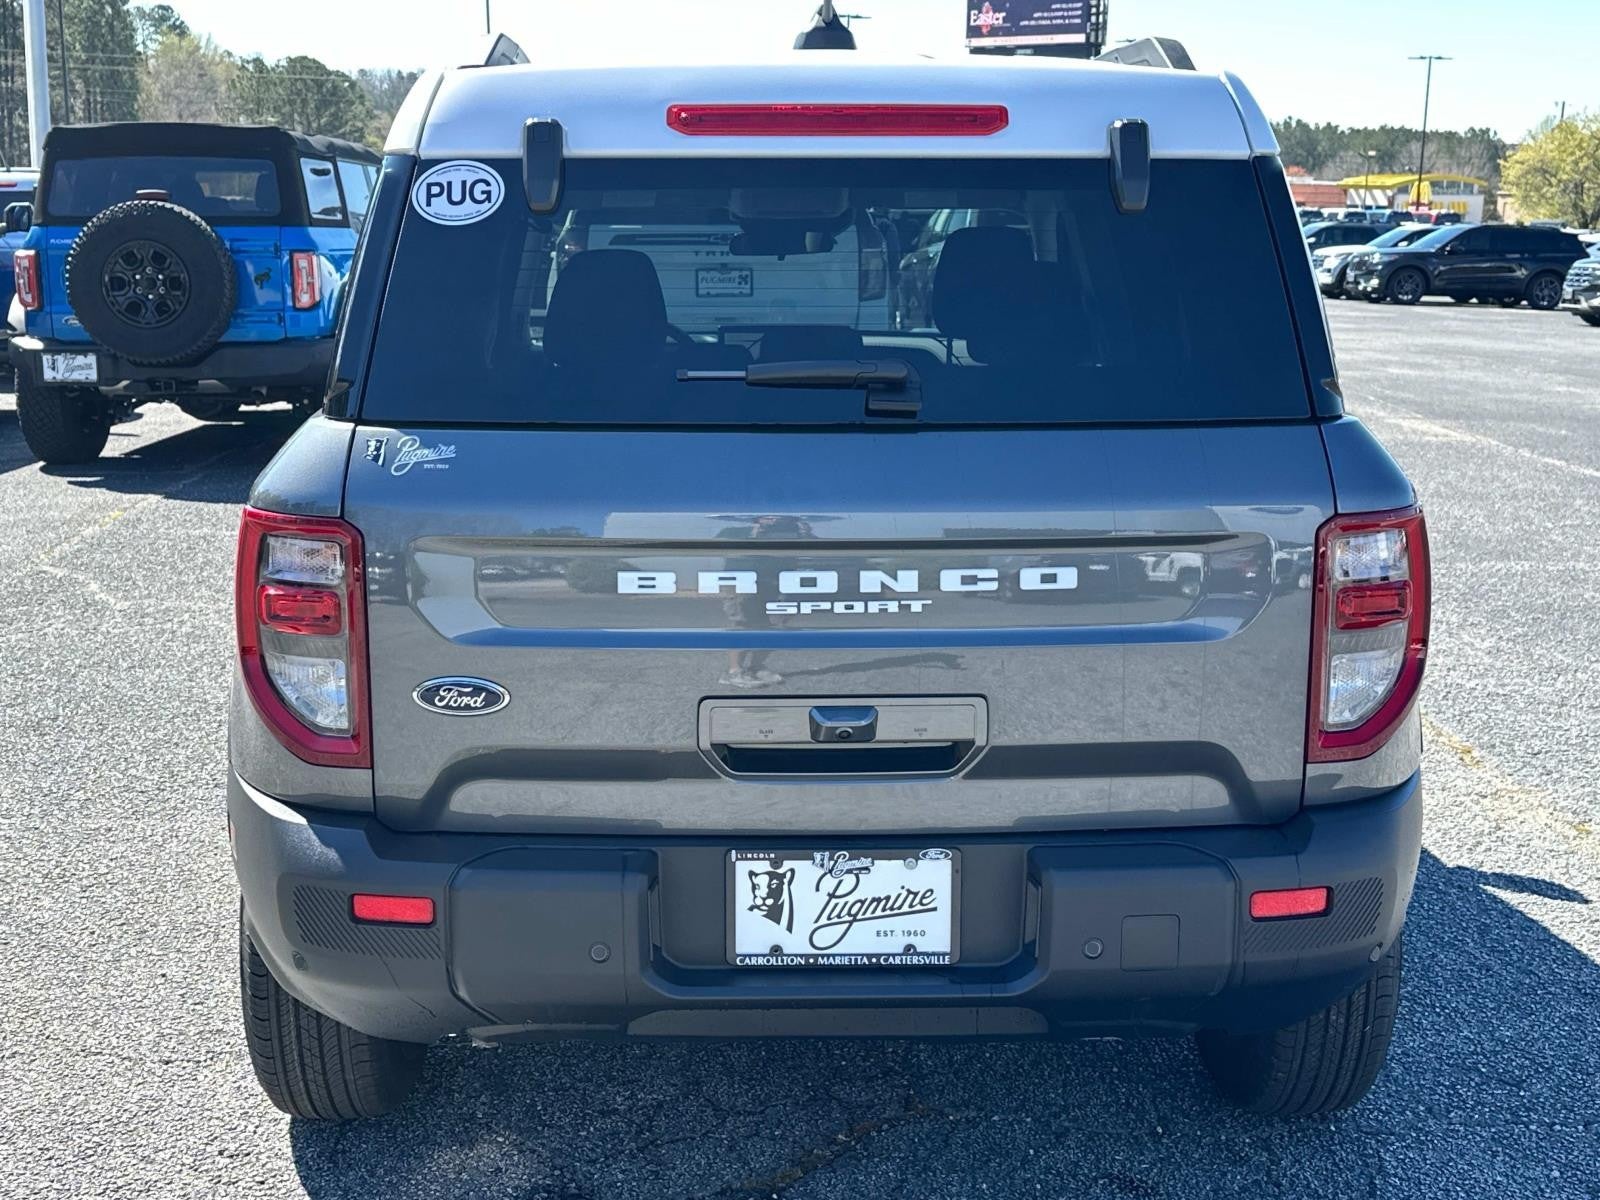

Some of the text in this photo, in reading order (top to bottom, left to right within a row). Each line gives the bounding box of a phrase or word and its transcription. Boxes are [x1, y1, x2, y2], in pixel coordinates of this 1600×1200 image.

[426, 178, 492, 207] PUG
[391, 435, 456, 476] Pugmire
[617, 566, 1078, 594] BRONCO
[766, 600, 932, 615] SPORT
[434, 685, 487, 707] Ford
[809, 872, 938, 951] Pugmire
[876, 929, 926, 937] EST. 1960
[736, 954, 950, 966] CARROLLTON MARIETTA CARTERSVILLE
